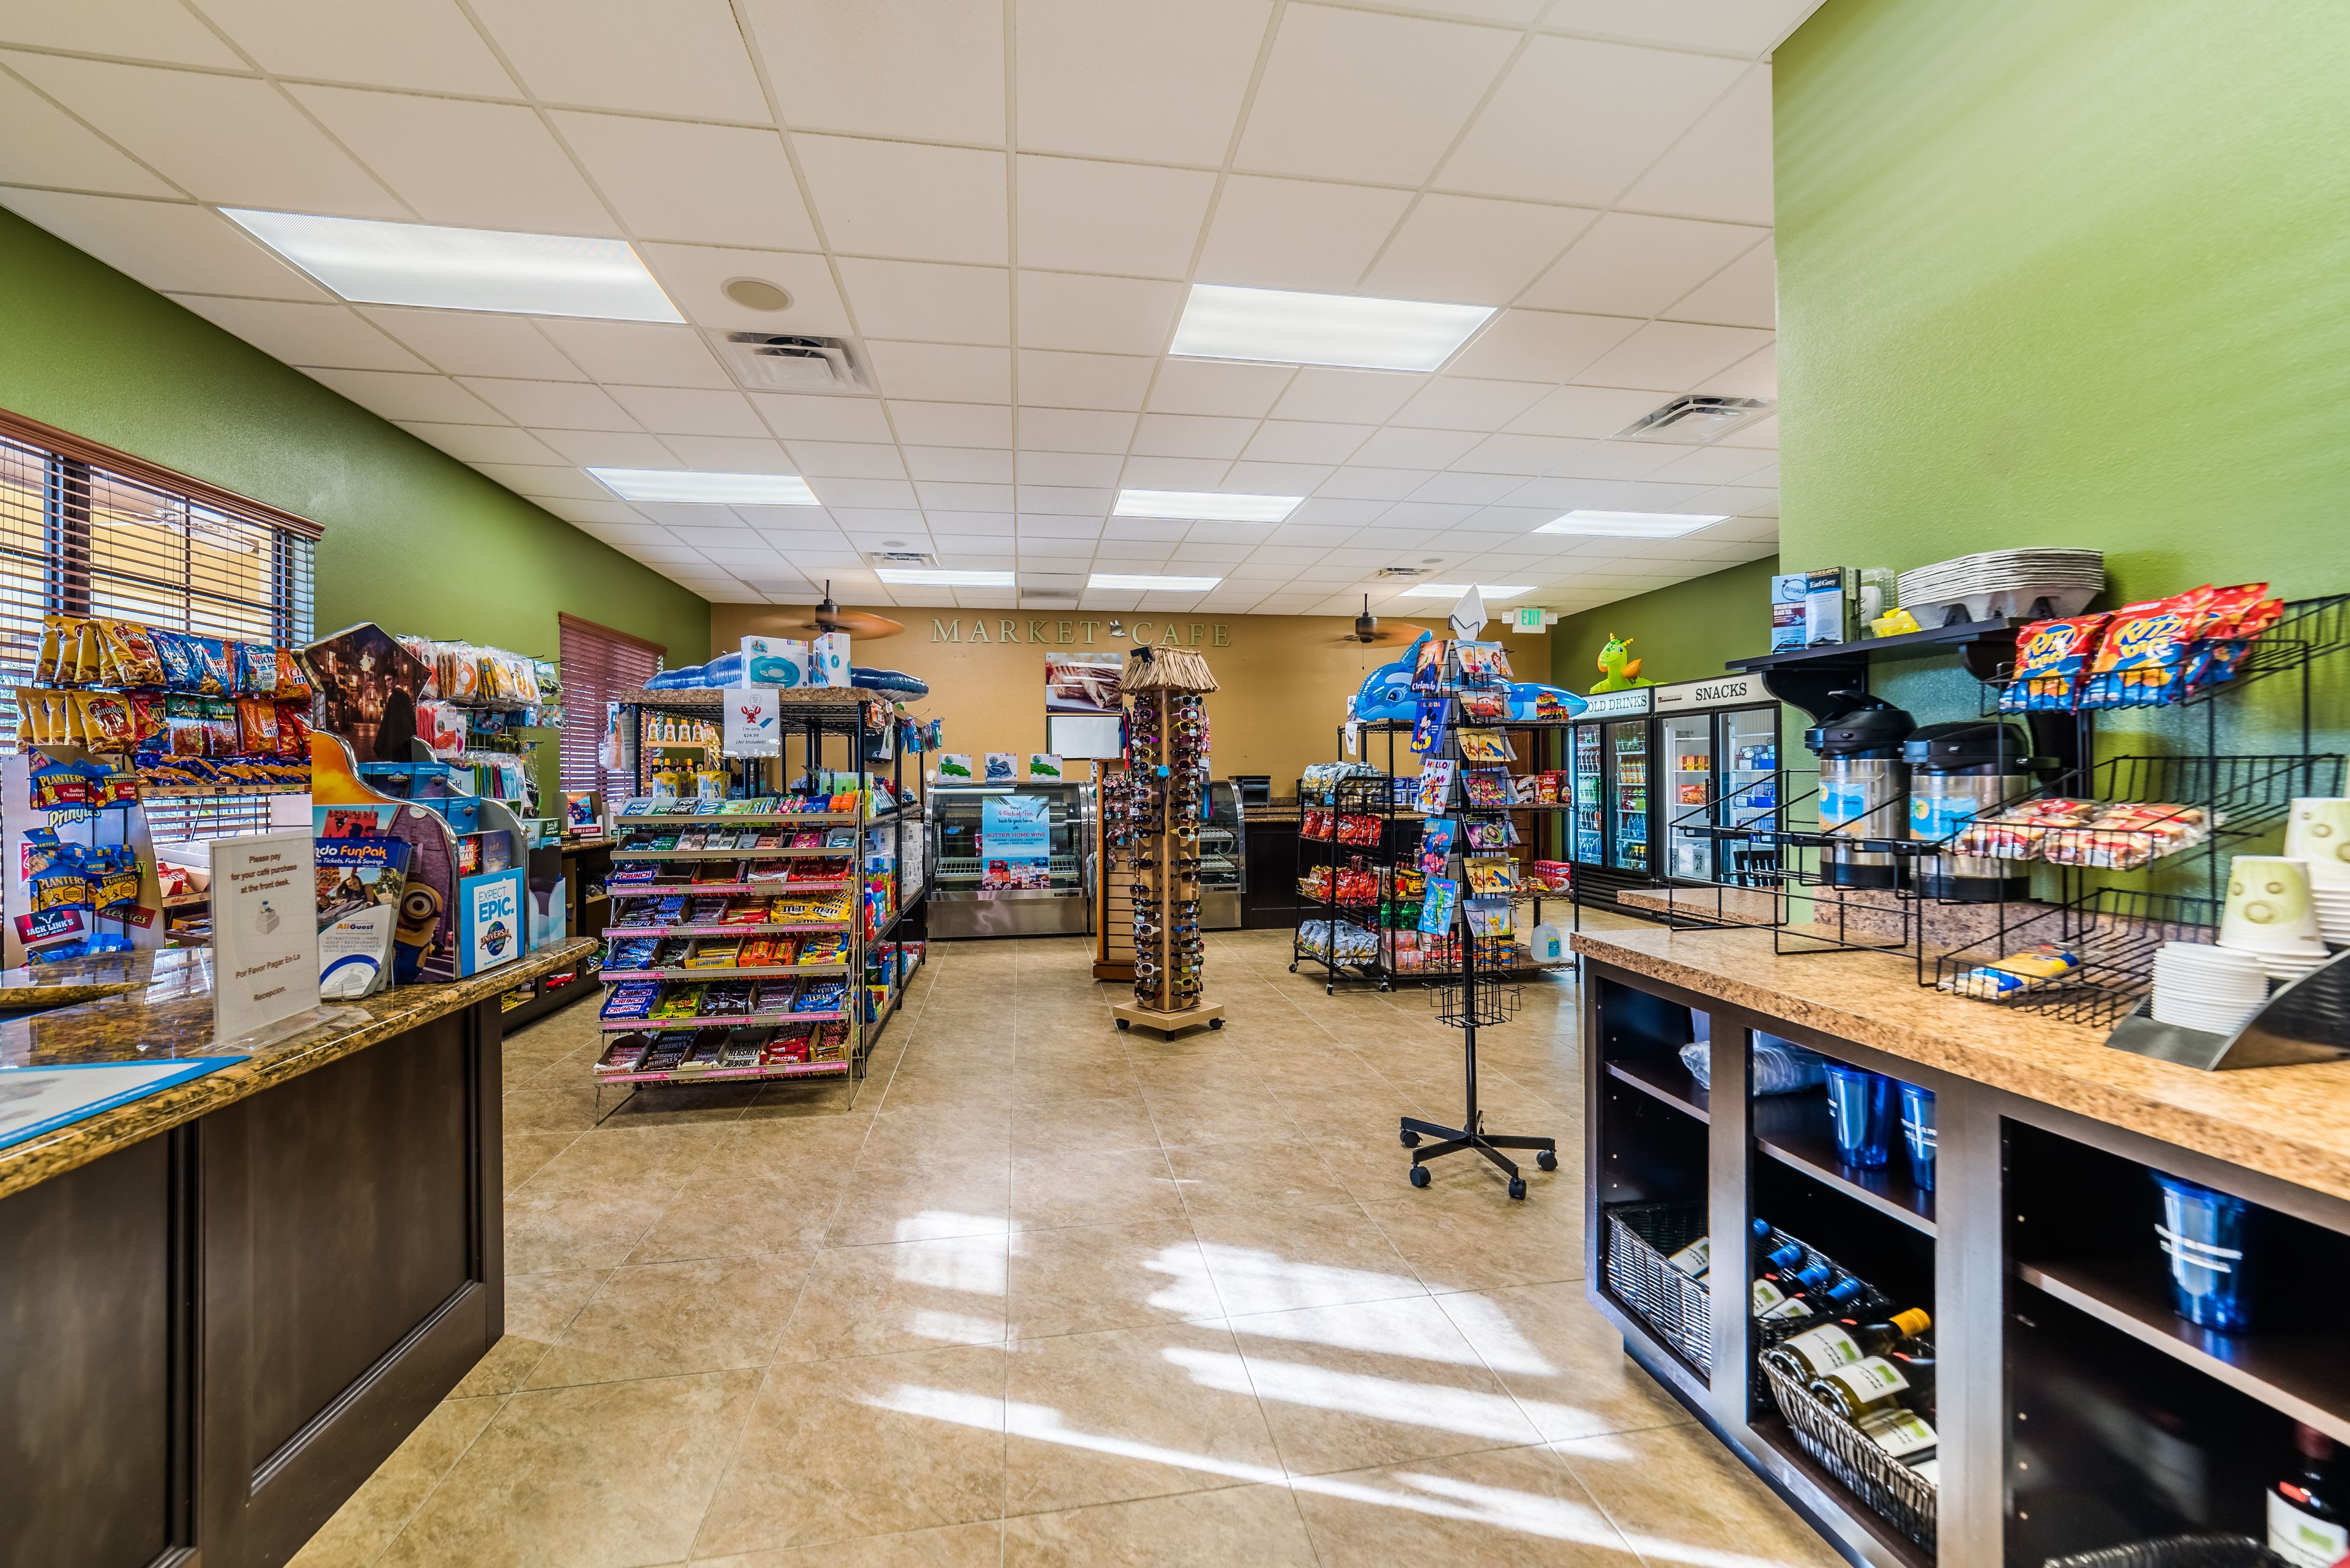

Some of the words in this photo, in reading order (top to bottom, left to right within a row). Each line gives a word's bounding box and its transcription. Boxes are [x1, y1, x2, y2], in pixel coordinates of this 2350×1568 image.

[1808, 567, 1840, 578] BIGELOW
[1784, 586, 1805, 595] RITUALS
[1522, 610, 1541, 626] EXIT
[930, 618, 1101, 644] MARKET
[1131, 621, 1231, 647] CAFE
[2114, 616, 2184, 646] RITZ
[2026, 627, 2076, 655] RITZ
[1412, 680, 1436, 691] Orlando
[1696, 682, 1747, 701] SNACKS
[88, 703, 126, 718] Gardetto's
[1584, 700, 1606, 714] OLD
[1609, 695, 1647, 711] DRINKS
[1427, 761, 1450, 771] HELLO!
[38, 774, 86, 787] PLANTERS
[327, 809, 379, 819] DESPICABLE
[248, 854, 269, 864] Please
[270, 853, 282, 862] pay
[340, 845, 387, 859] FunPak
[230, 873, 241, 881] for
[241, 870, 256, 881] your
[257, 867, 270, 876] café
[270, 864, 297, 876] purchase
[38, 876, 86, 890] PLANTERS
[102, 873, 136, 887] PLANTERS
[259, 881, 275, 890] front
[275, 878, 291, 887] desk.
[478, 886, 507, 903] EXPECT
[479, 896, 515, 924] EPIC.
[26, 925, 46, 936] JACK
[47, 918, 74, 931] LINK'S
[480, 927, 512, 945] UNIVERSAL
[236, 971, 247, 979] Por
[248, 965, 266, 975] Favor
[267, 958, 285, 969] Pagar
[285, 955, 293, 964] En
[657, 1042, 687, 1050] HERSHEY'S
[647, 1056, 677, 1066] HERSHEY'S
